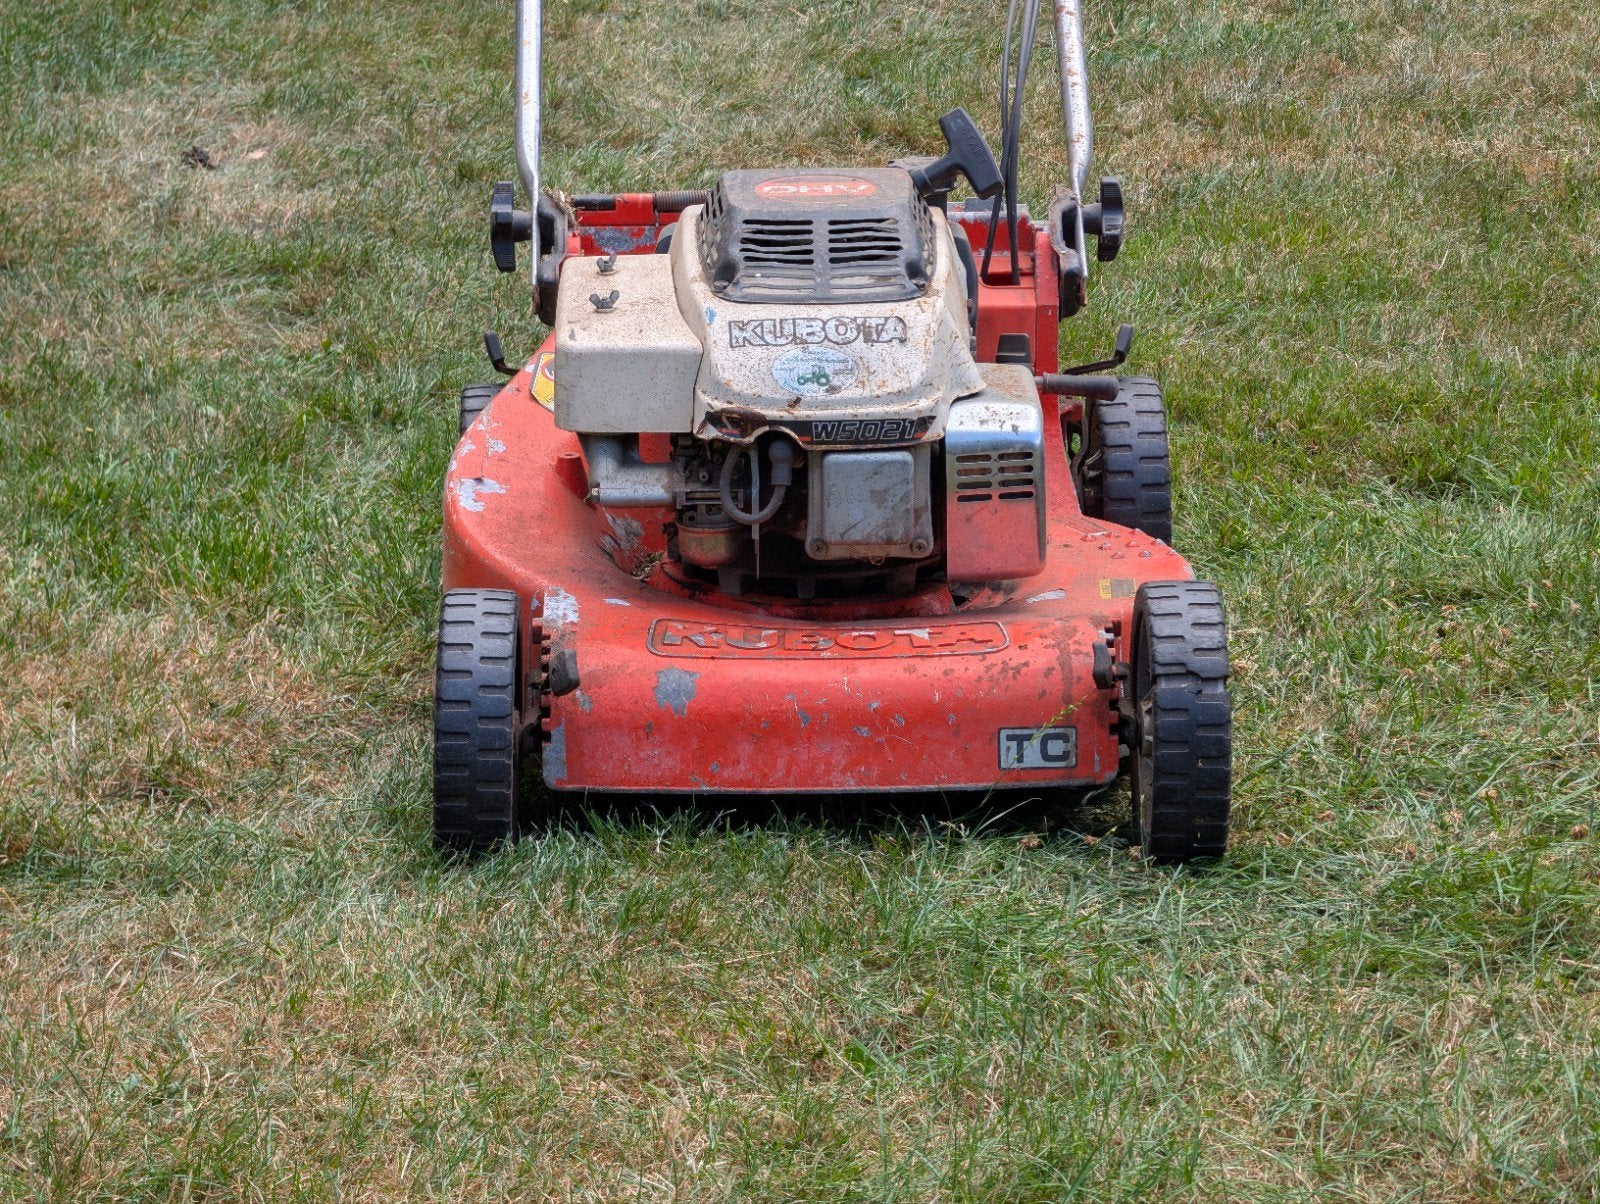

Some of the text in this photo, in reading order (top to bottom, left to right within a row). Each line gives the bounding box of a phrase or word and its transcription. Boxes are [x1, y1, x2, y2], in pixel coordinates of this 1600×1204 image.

[728, 316, 908, 348] KUBOTA
[812, 419, 916, 441] W5021
[662, 622, 994, 651] KUBOTA
[1006, 732, 1071, 764] TC
